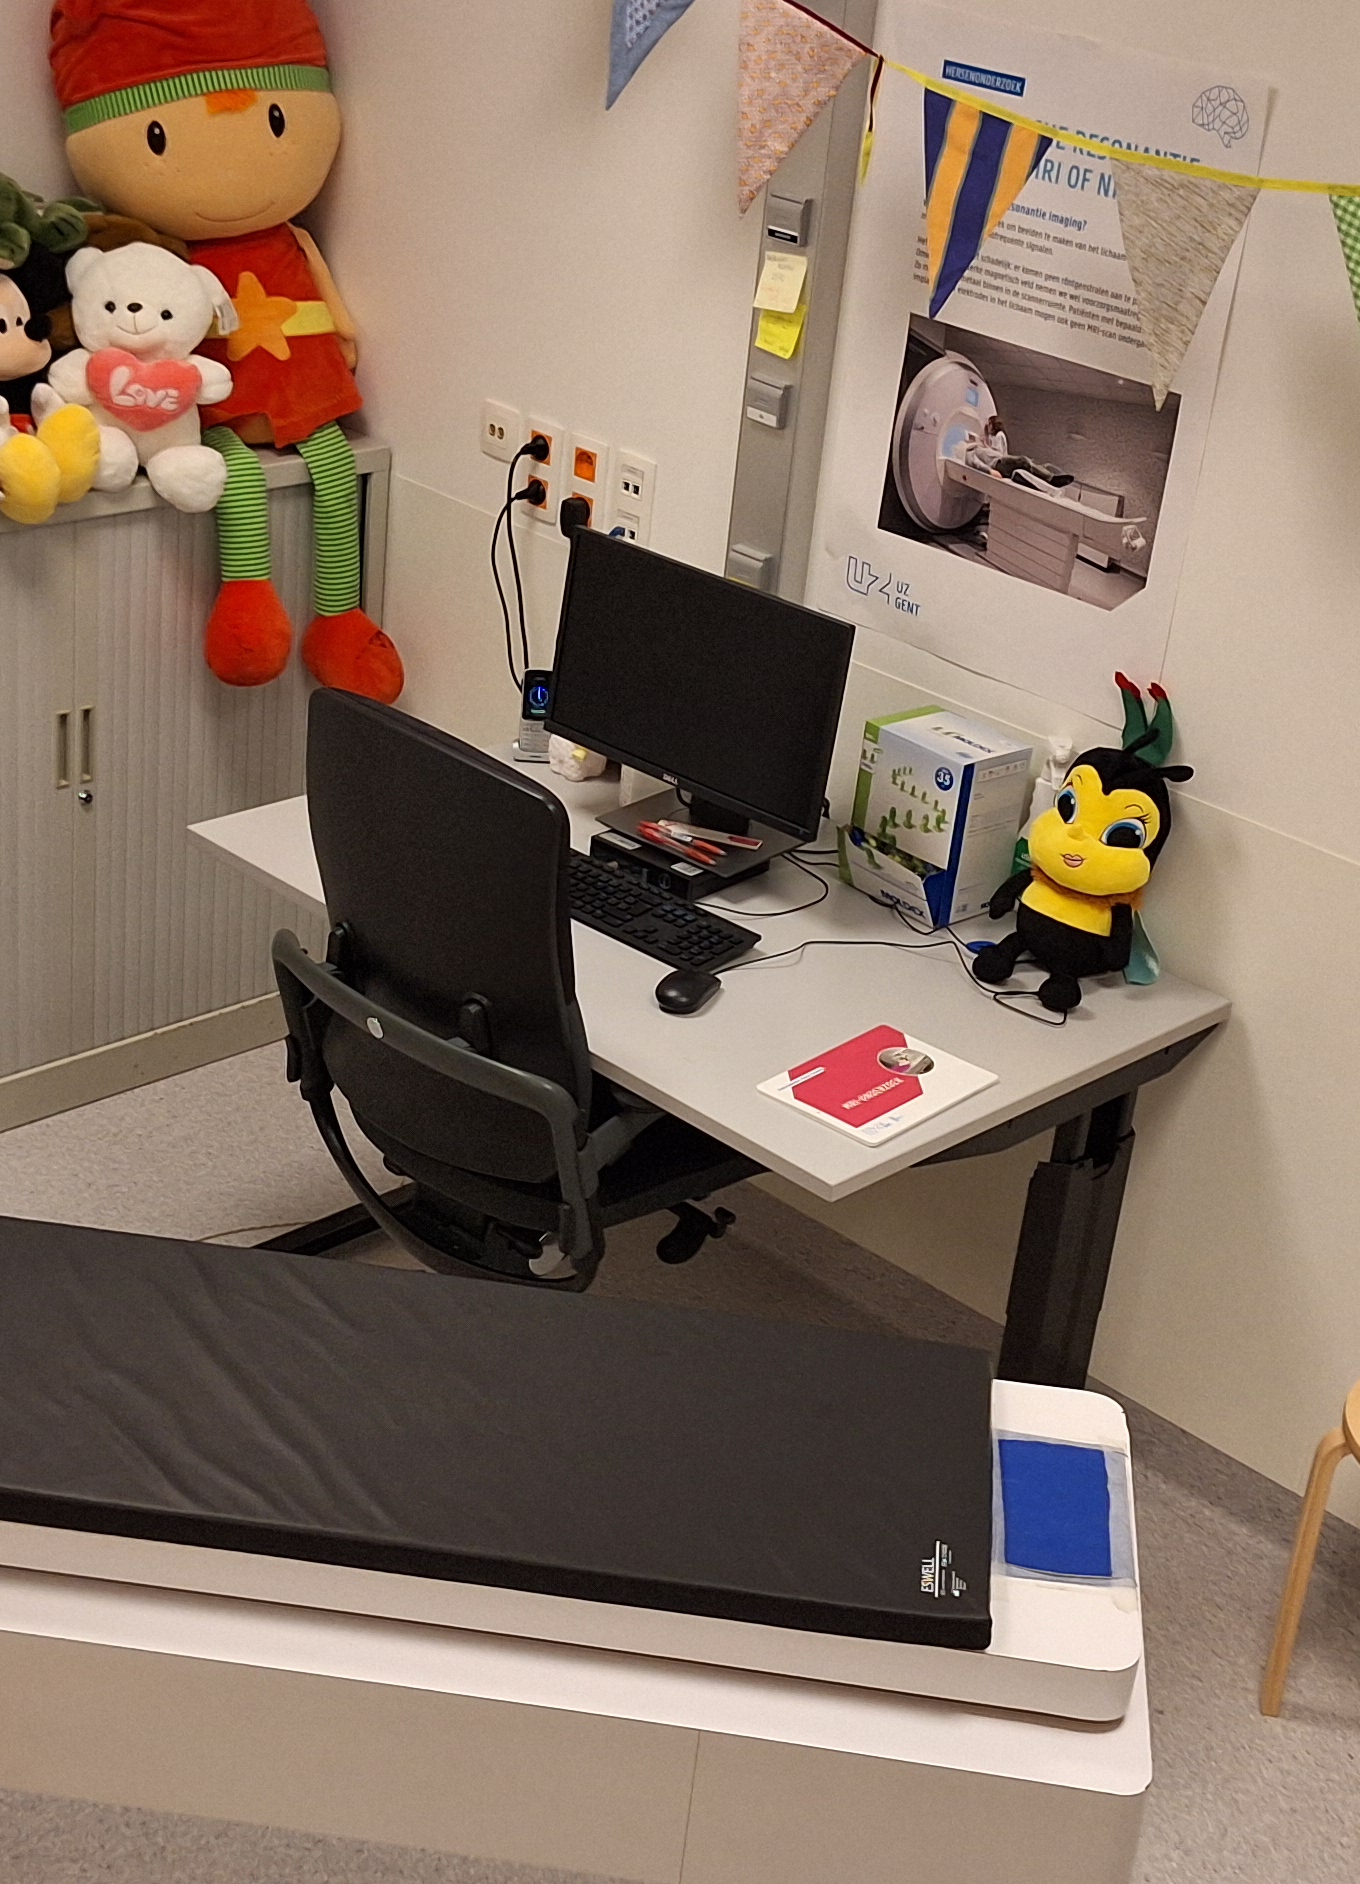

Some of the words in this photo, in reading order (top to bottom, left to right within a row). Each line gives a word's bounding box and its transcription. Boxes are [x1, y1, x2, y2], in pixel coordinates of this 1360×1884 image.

[945, 65, 1023, 93] HERSENONDERZOEK
[1067, 164, 1093, 191] OF
[1097, 172, 1117, 200] N
[1007, 202, 1047, 220] sonantie
[1048, 210, 1087, 231] imaging?
[1075, 242, 1086, 251] van
[1088, 244, 1099, 254] het
[896, 581, 910, 597] UZ
[894, 596, 921, 616] GENT
